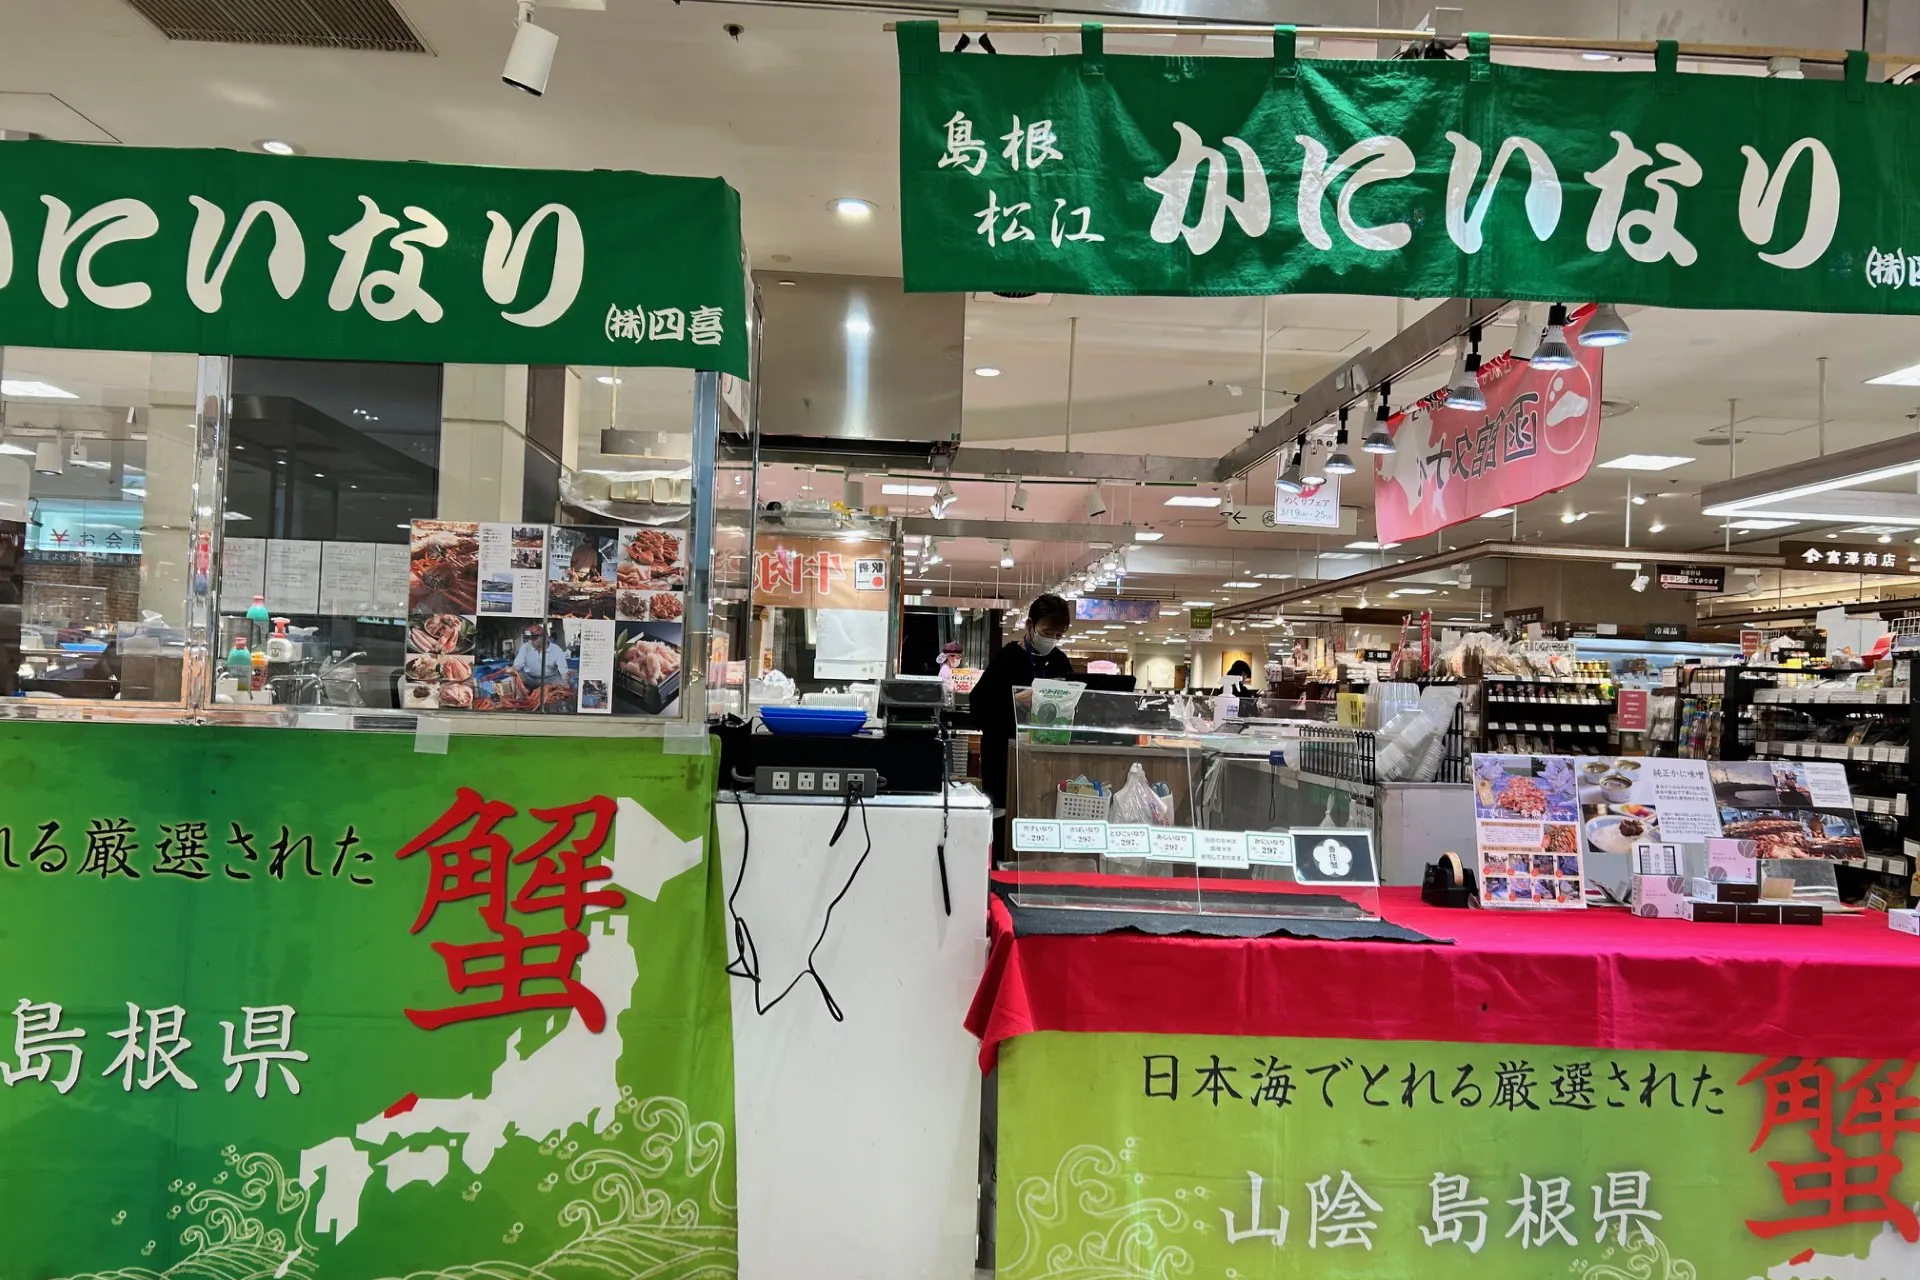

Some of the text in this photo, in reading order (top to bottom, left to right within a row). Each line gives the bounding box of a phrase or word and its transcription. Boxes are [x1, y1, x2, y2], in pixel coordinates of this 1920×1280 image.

[935, 110, 1062, 176] 島根
[974, 195, 1106, 248] 松江
[1143, 120, 1842, 270] かにいなり
[0, 193, 586, 328] にいなり
[604, 303, 725, 346] (株)四喜
[1652, 768, 1705, 780] 純正かに味噌
[0, 818, 374, 886] る厳選された
[394, 786, 627, 1036] 蟹
[0, 998, 309, 1098] 島根県
[1141, 1054, 1726, 1116] 日本海でとれる厳選された
[1220, 1169, 1664, 1254] 山陰 島根県
